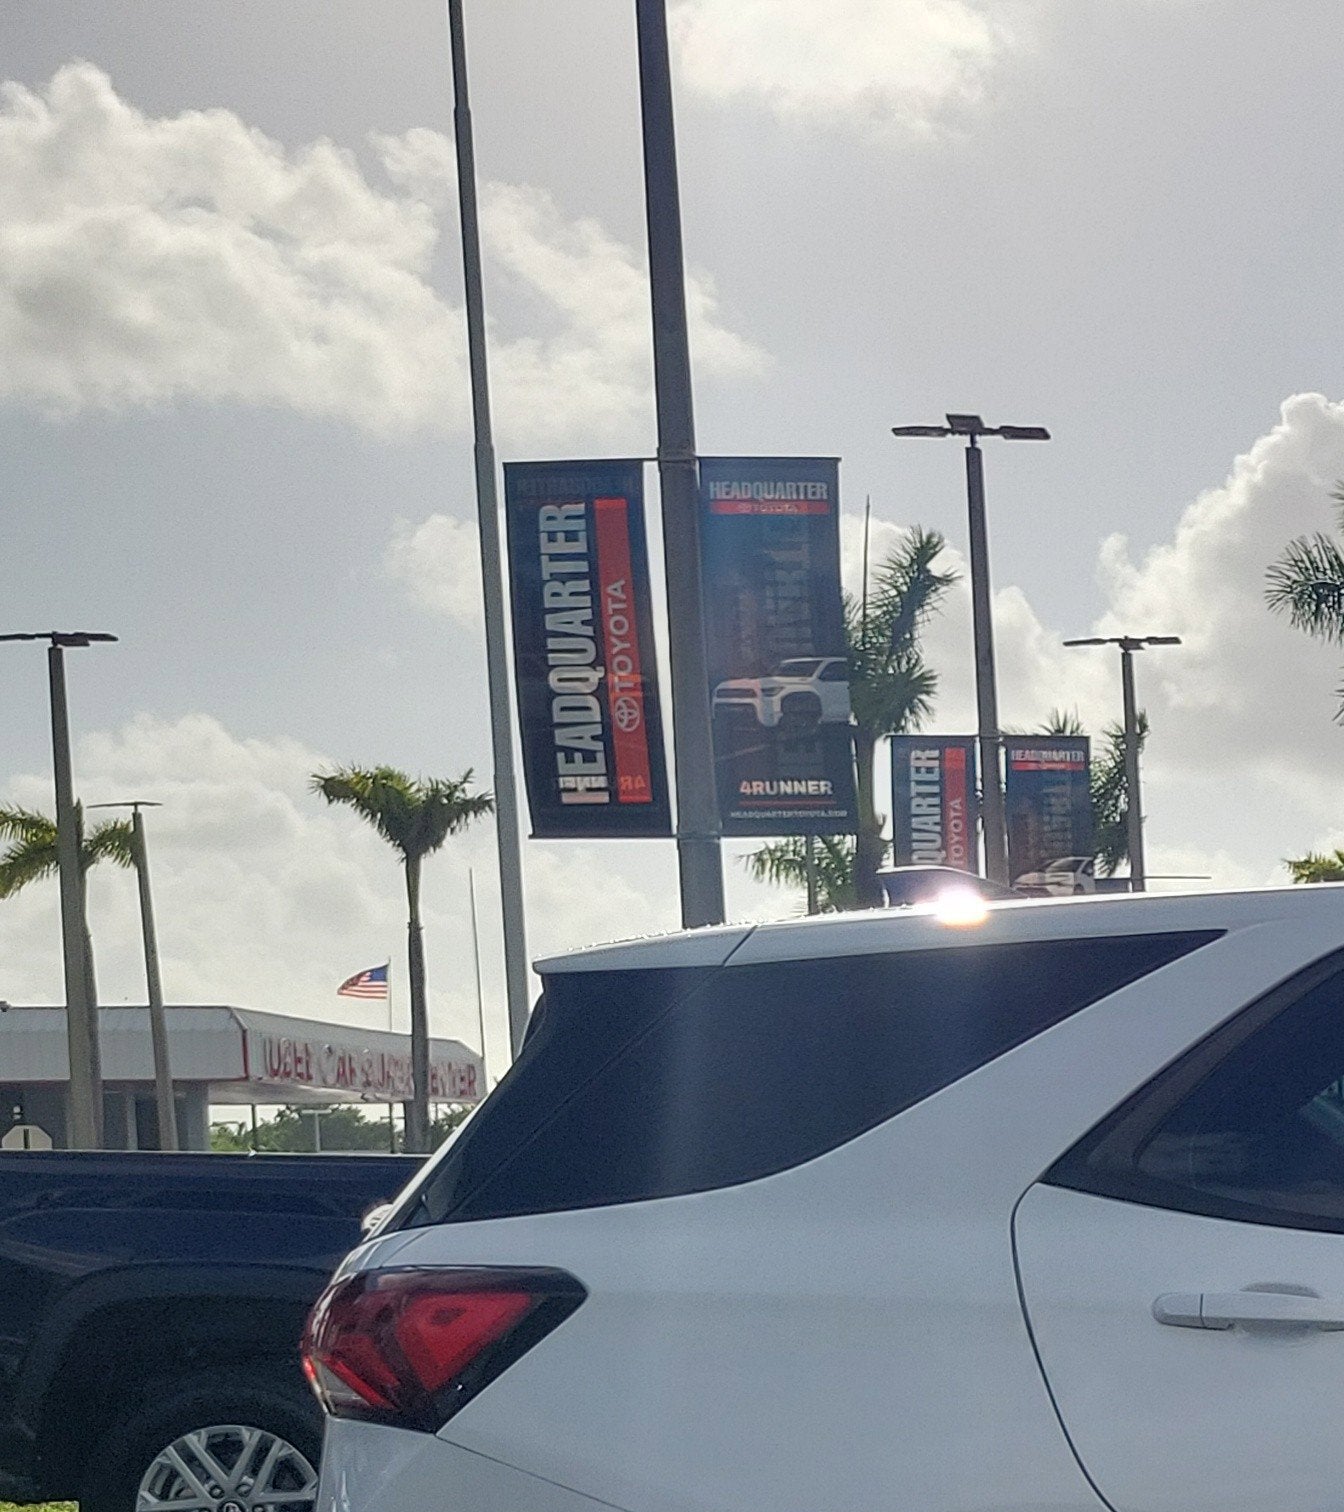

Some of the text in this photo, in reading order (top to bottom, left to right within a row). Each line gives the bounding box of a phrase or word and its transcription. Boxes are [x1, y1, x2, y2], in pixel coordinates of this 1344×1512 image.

[709, 480, 829, 500] HEADQUARTER
[539, 503, 609, 803] HEADQUARTER
[606, 580, 633, 692] TOYOTA
[740, 780, 833, 796] 4RUNNER
